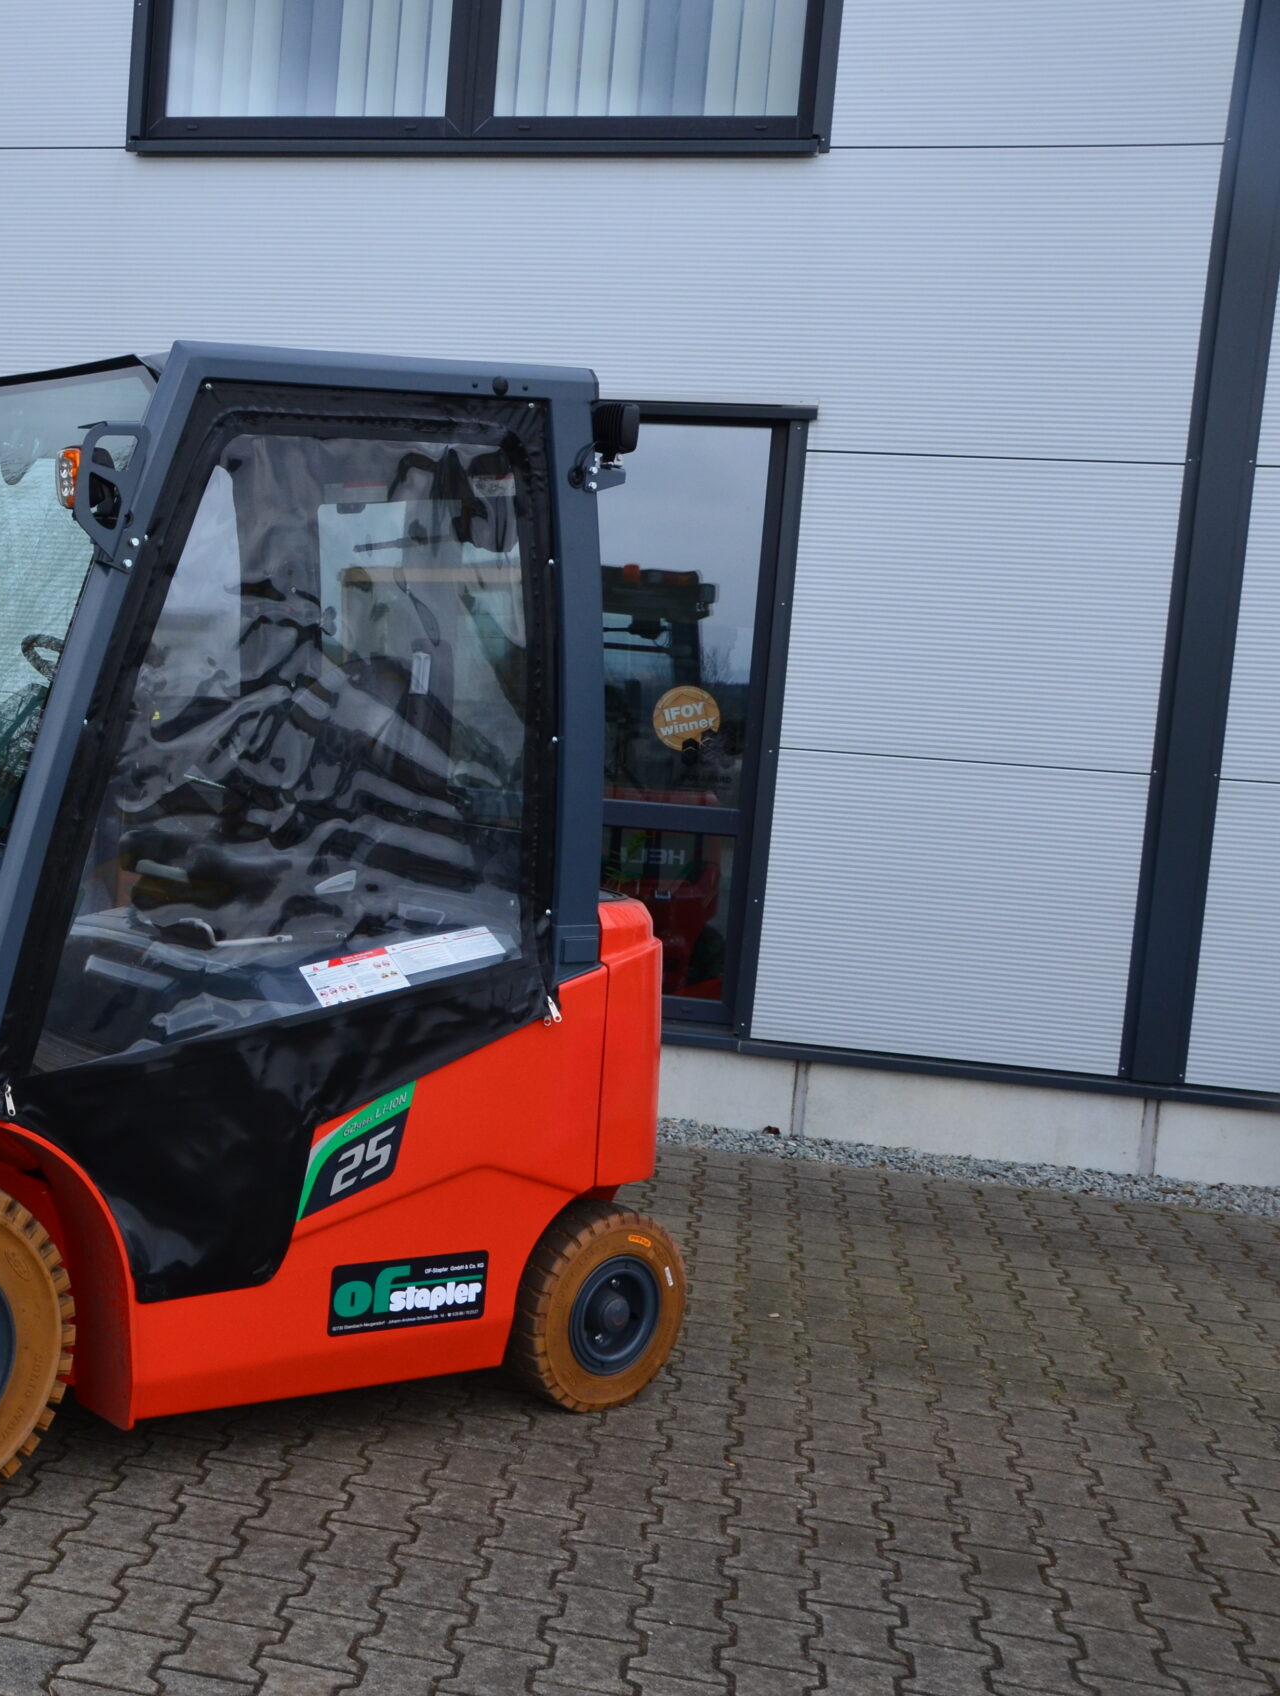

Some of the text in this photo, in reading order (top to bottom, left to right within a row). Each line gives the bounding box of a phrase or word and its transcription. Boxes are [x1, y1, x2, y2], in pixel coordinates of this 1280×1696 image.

[660, 717, 716, 736] winner
[663, 702, 704, 722] IFOY
[329, 1126, 396, 1197] 25
[333, 1265, 482, 1318] of stapler
